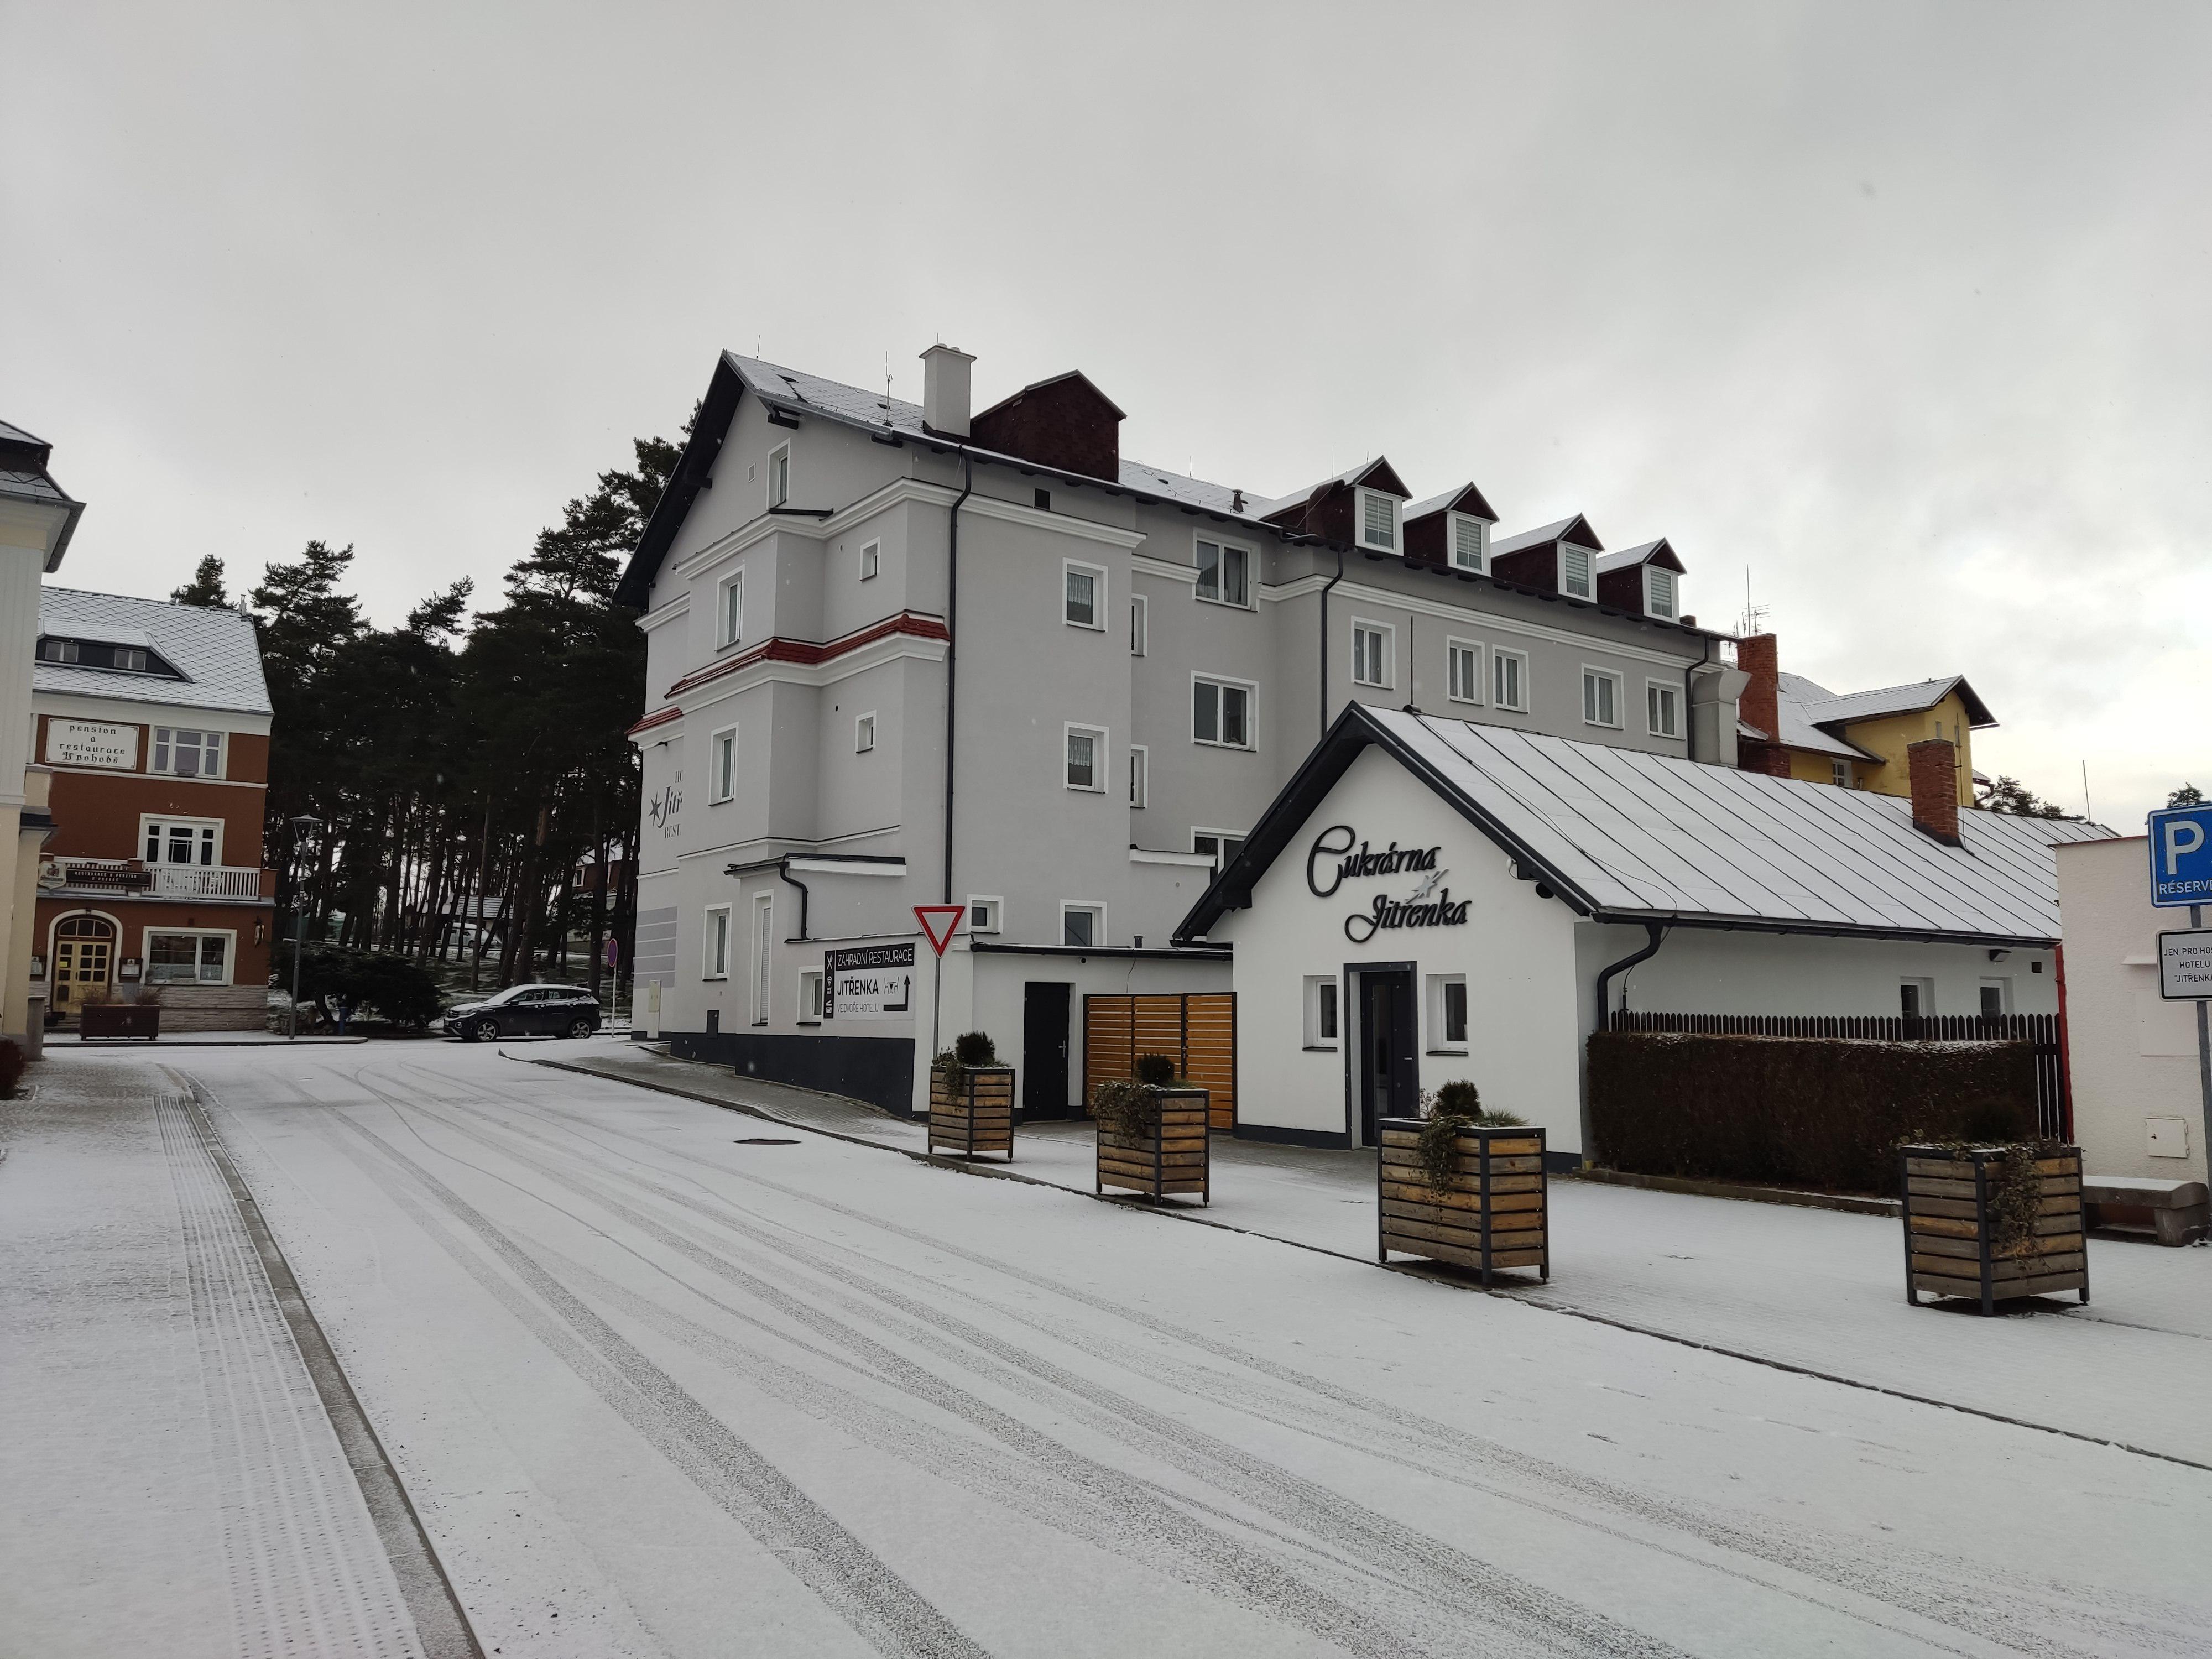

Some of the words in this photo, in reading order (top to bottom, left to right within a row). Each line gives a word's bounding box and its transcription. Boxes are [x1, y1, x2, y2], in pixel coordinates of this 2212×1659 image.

[70, 725, 116, 735] pension
[59, 743, 125, 755] restaurace
[2164, 820, 2204, 875] P
[1307, 825, 1441, 898] Cukrárna
[838, 949, 869, 967] ZÁHRADNÍ
[869, 948, 912, 964] RESTAURACE
[2179, 960, 2210, 968] HOTELU
[837, 976, 879, 996] JITŘENKA
[837, 1004, 843, 1013] VE
[859, 1003, 879, 1013] HOTELU
